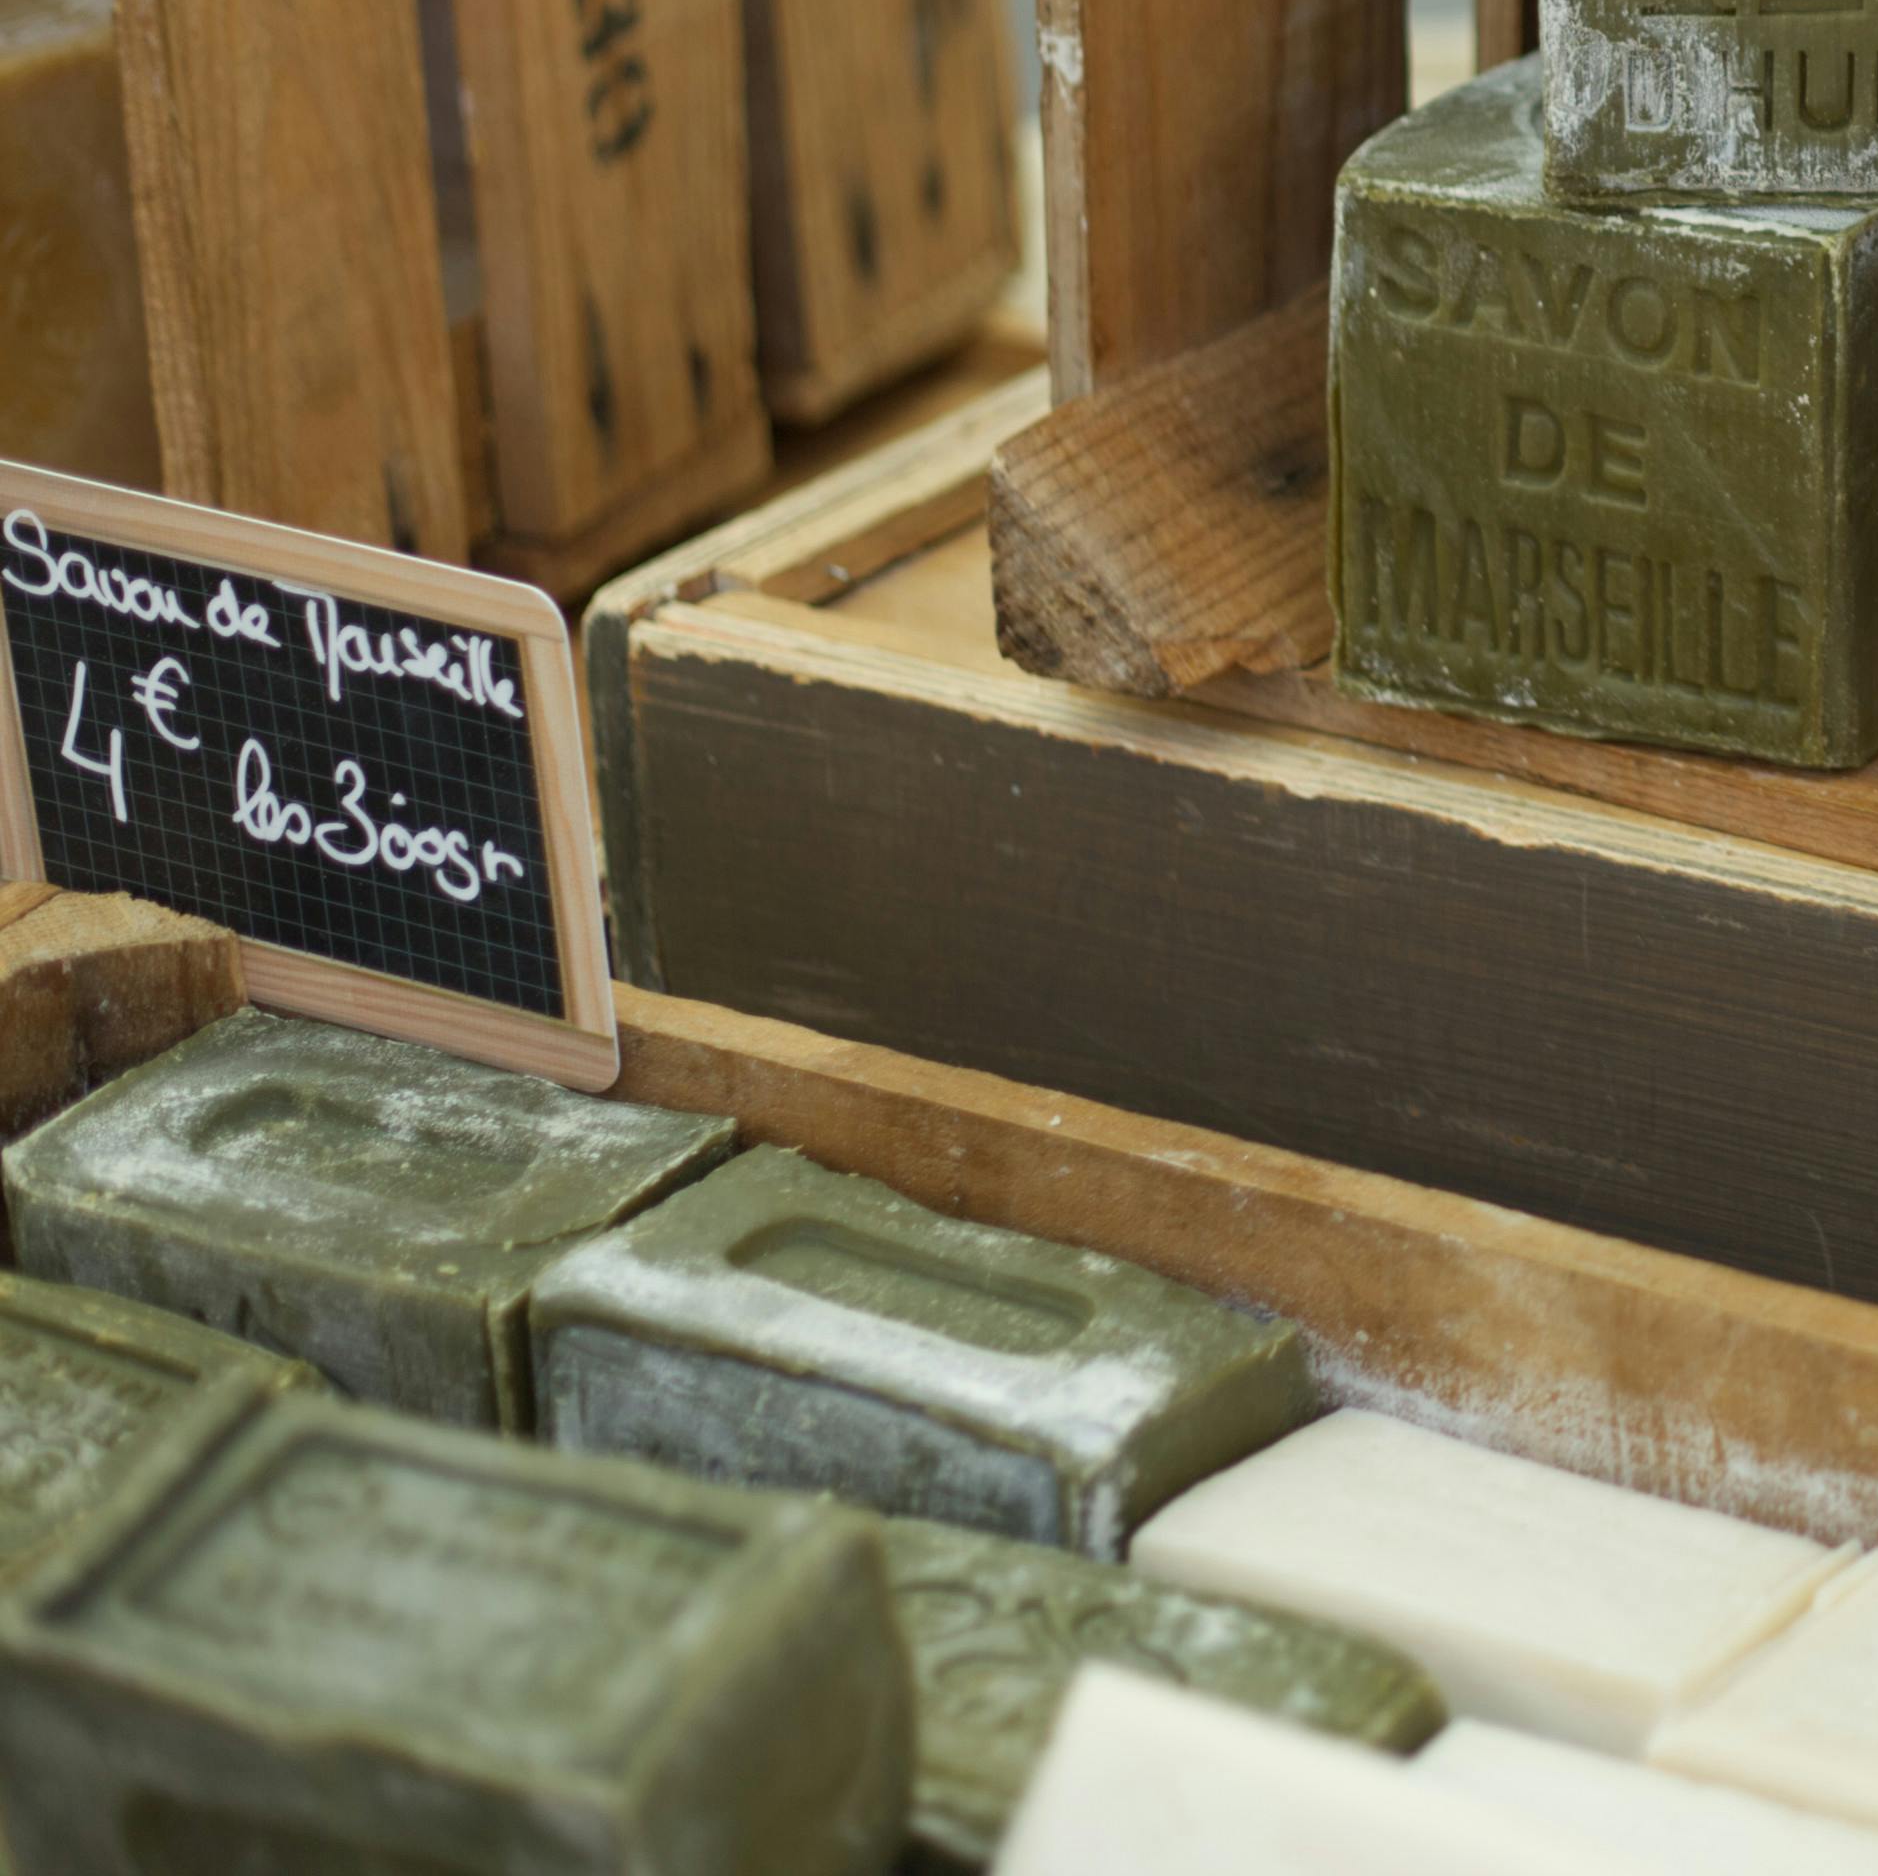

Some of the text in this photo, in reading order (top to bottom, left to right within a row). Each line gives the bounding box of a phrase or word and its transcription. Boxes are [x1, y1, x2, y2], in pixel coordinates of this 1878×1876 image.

[1375, 227, 1763, 387] SAVON
[1501, 394, 1649, 511] DE
[2, 509, 199, 629] Savon
[207, 578, 281, 648] de
[1354, 494, 1803, 709] MARSEILLE
